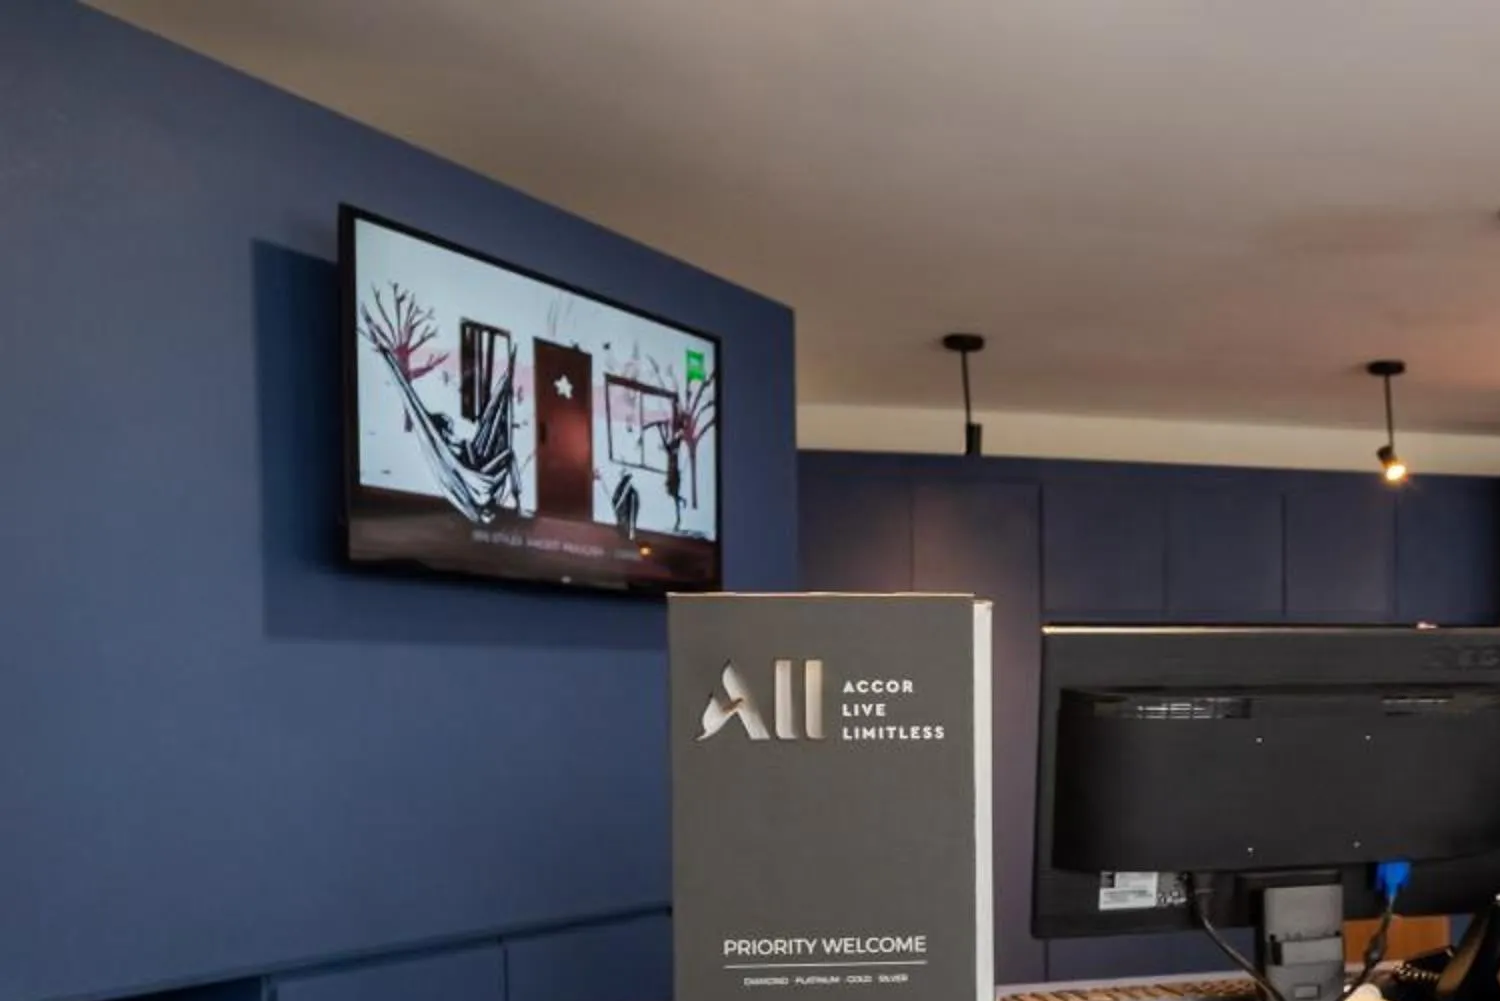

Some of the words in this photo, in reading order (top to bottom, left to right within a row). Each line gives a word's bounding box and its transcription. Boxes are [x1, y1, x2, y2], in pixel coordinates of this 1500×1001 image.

[842, 680, 914, 694] ACCOR
[842, 703, 887, 718] LIVE
[842, 726, 945, 740] LIMITLESS
[723, 938, 817, 956] PRIORITY
[821, 935, 927, 954] WELCOME
[744, 977, 789, 986] DIAMOND
[795, 976, 840, 985] PLATINUM
[846, 975, 872, 984] GOLD
[878, 973, 909, 983] SILVER
